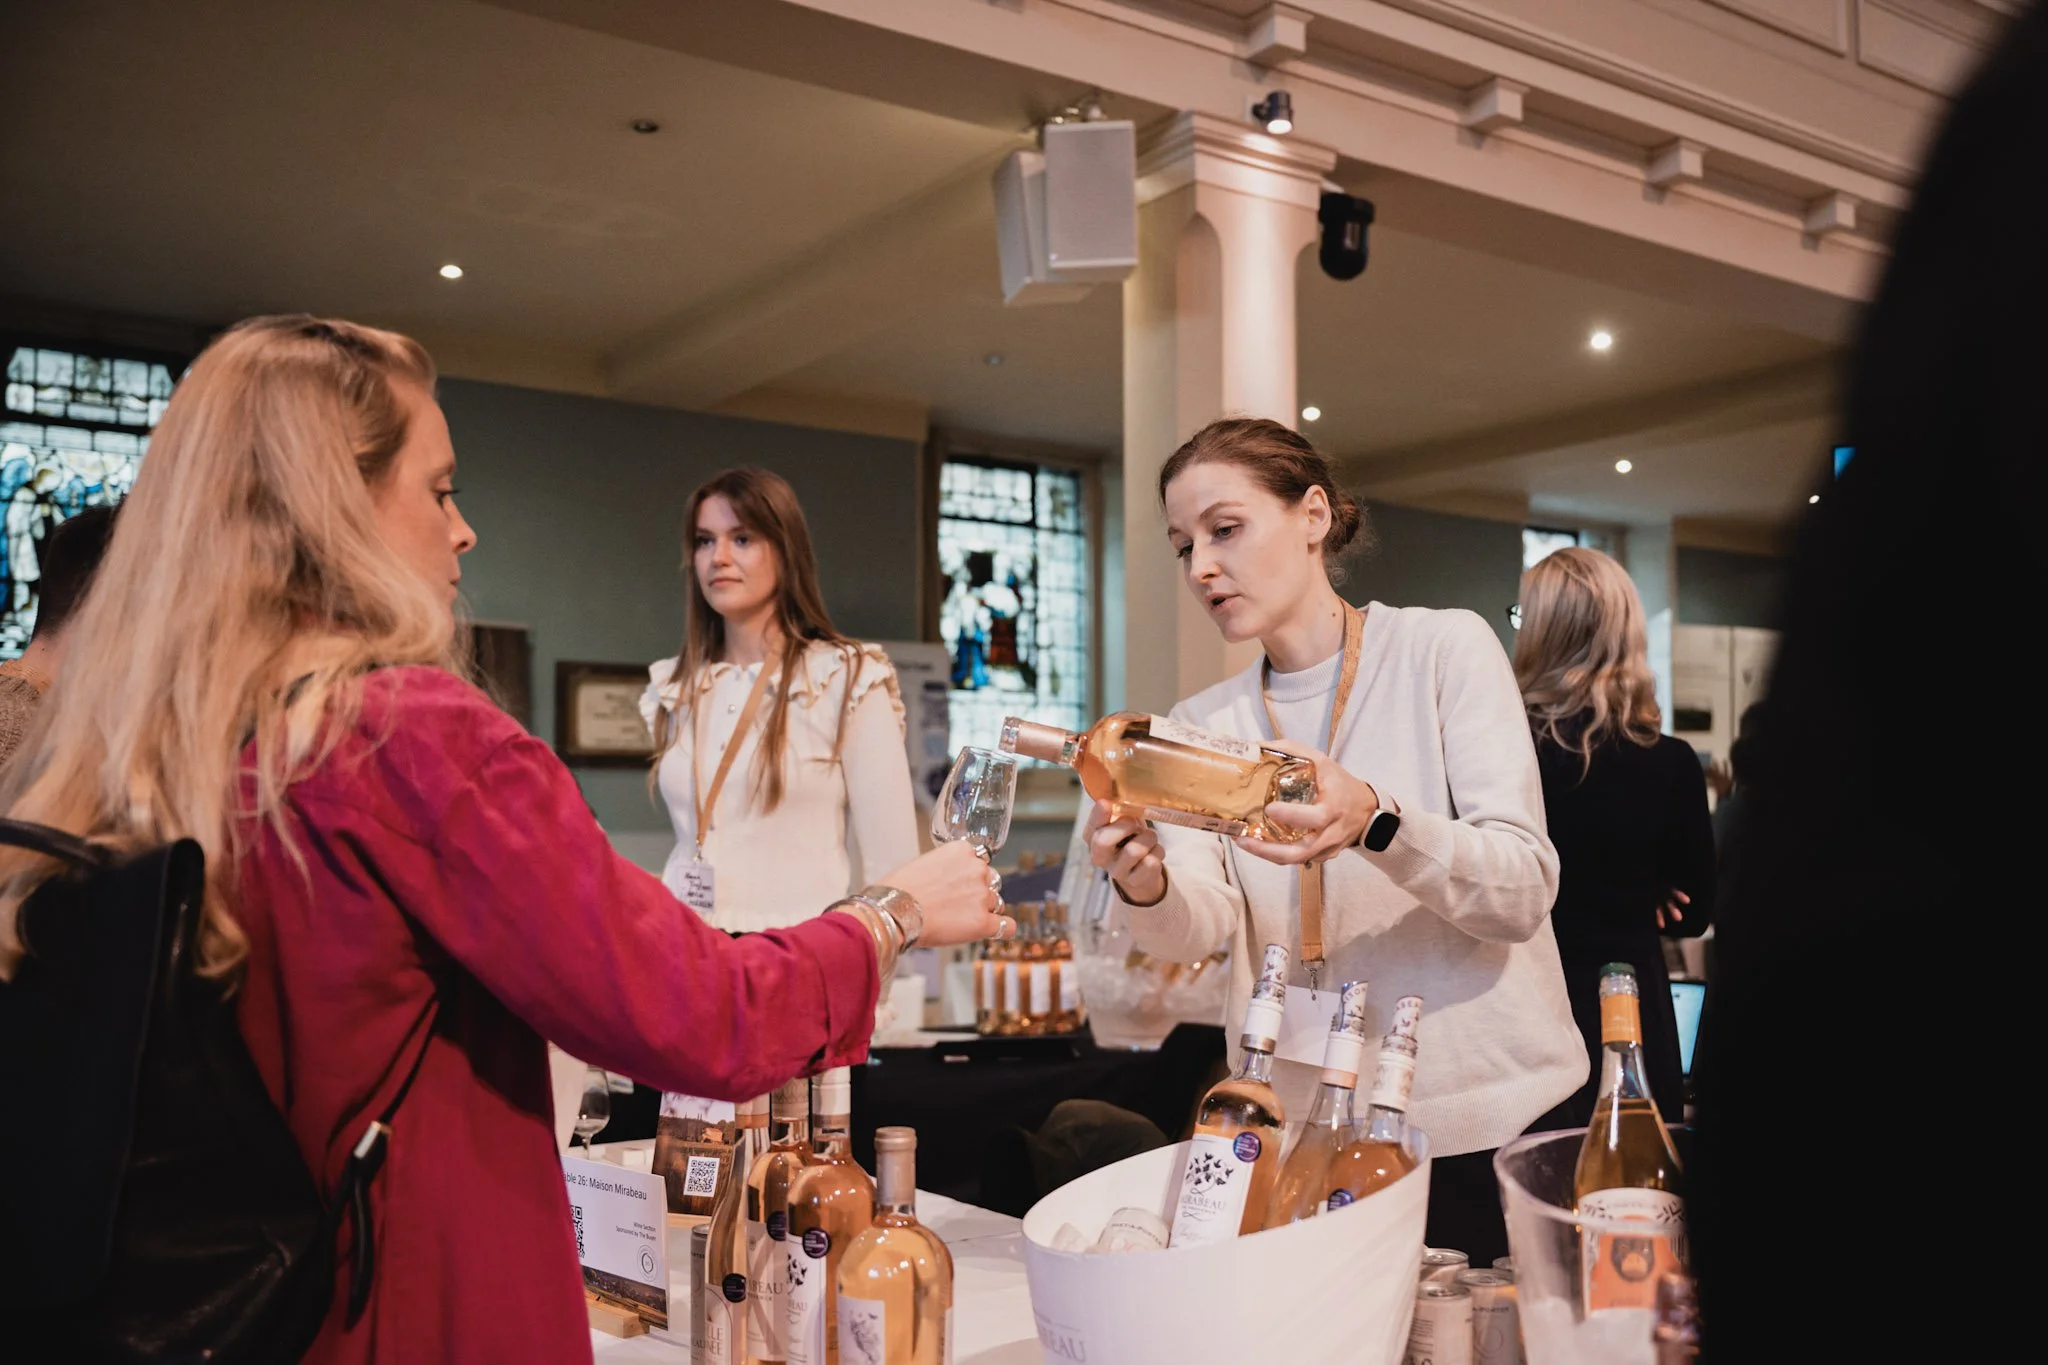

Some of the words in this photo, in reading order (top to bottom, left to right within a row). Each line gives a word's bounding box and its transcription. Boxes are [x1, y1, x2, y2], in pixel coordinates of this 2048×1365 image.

[562, 1171, 577, 1184] able
[577, 1174, 589, 1187] 26:
[589, 1177, 614, 1193] Maison
[614, 1184, 648, 1200] Mirabeau
